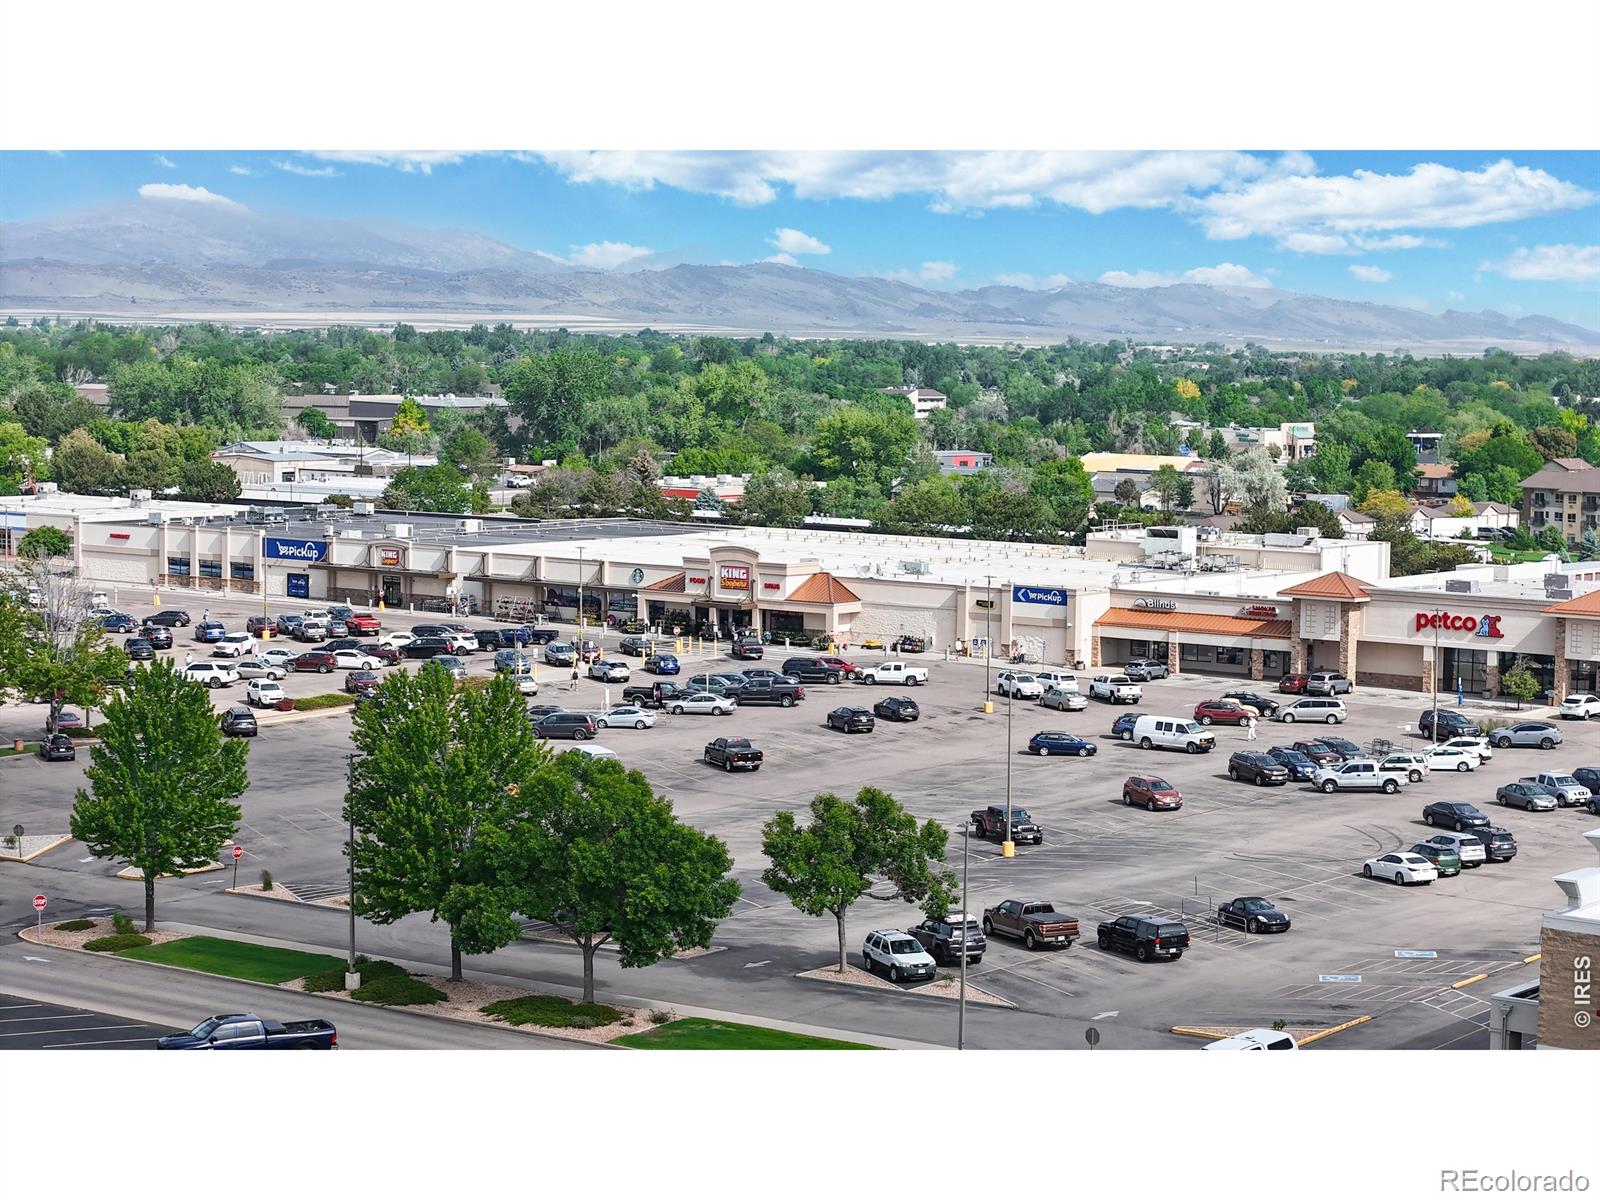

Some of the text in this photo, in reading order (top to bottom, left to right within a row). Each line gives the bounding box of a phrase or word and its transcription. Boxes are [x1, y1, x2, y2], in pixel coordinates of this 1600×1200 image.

[289, 543, 319, 562] Pickup
[721, 568, 747, 579] KING
[1037, 591, 1062, 603] Pickup
[1147, 598, 1177, 609] Blinds
[1416, 612, 1477, 632] petco
